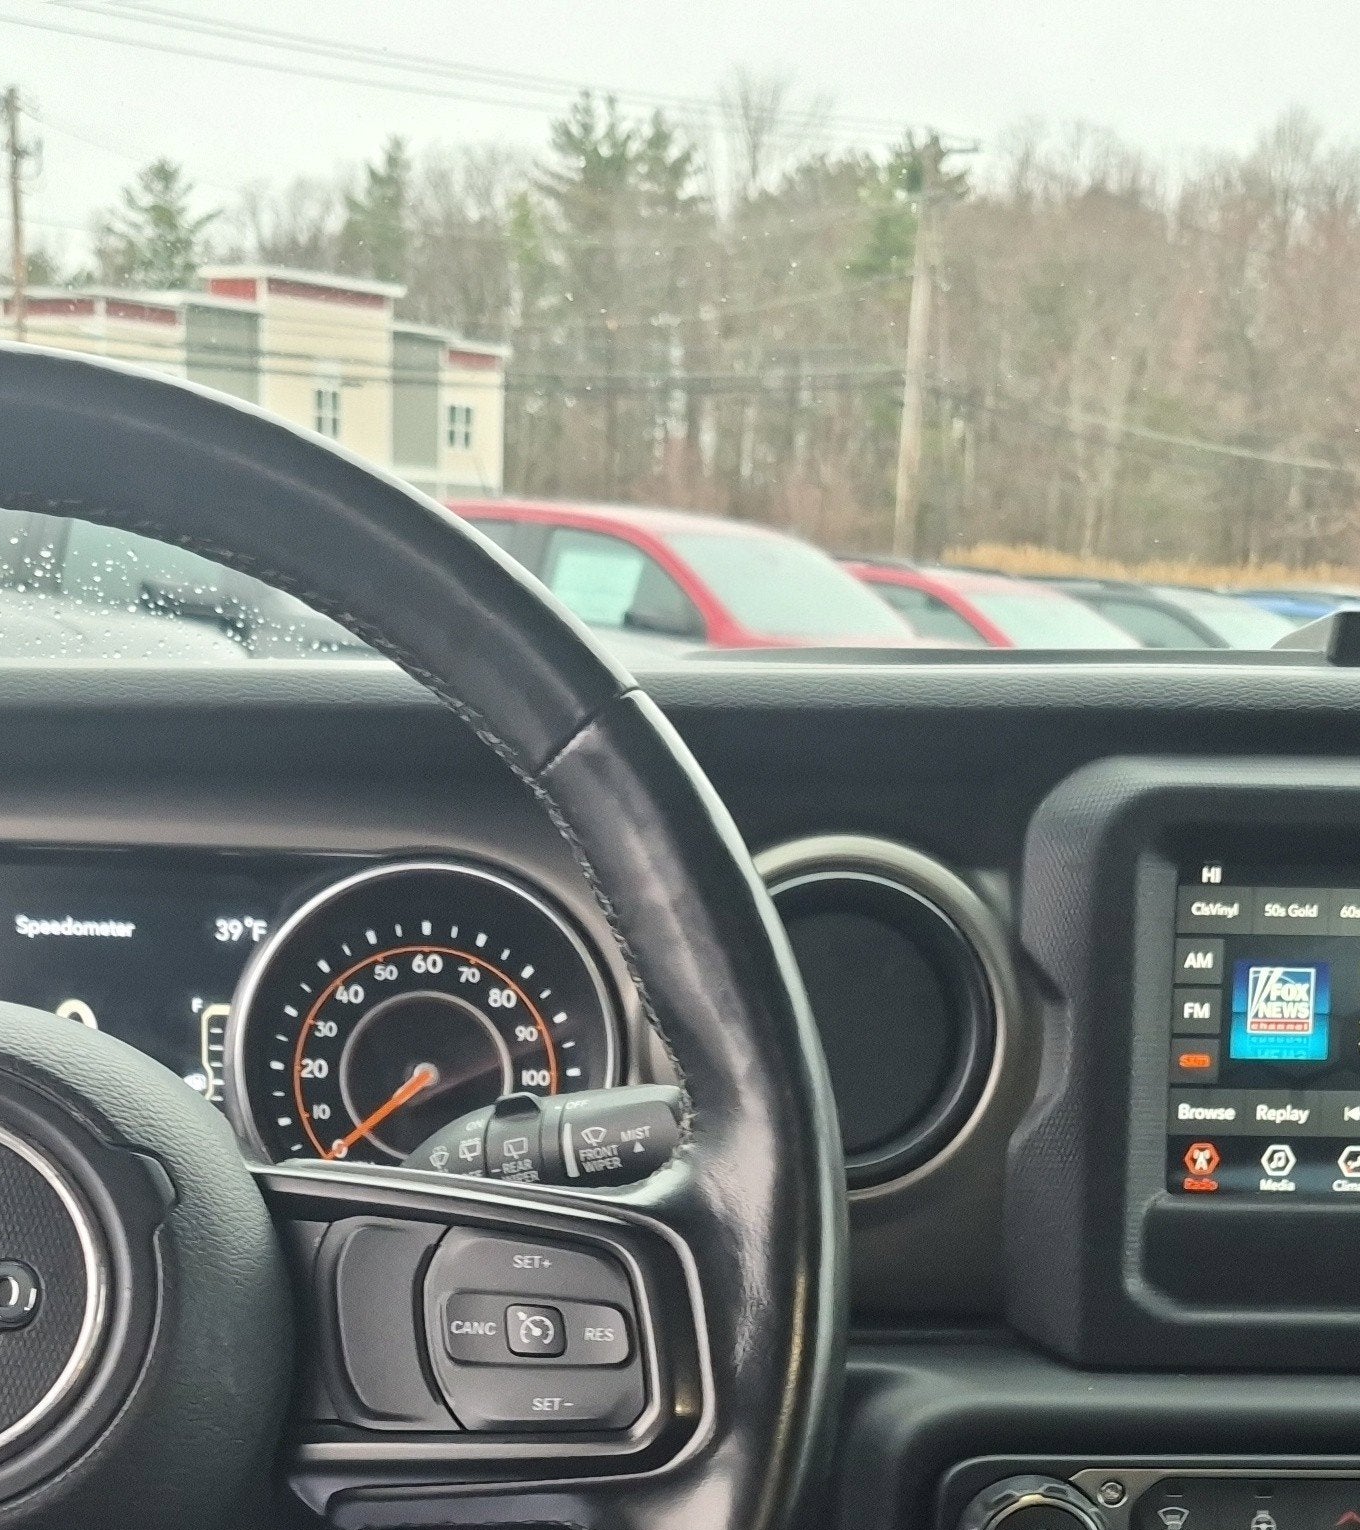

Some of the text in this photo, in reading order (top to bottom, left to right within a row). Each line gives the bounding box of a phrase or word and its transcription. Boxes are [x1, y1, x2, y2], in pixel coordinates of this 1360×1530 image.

[1191, 902, 1240, 919] ClsVinyl
[1264, 903, 1318, 918] 50s Gold
[15, 914, 136, 938] Speedometer
[412, 954, 444, 975] 60
[1183, 952, 1214, 969] AM
[374, 964, 399, 984] 50
[458, 965, 481, 984] 70
[336, 984, 364, 1004] 40
[488, 989, 518, 1009] 80
[1270, 983, 1310, 1001] FOX
[1183, 1002, 1211, 1020] FM
[1258, 1001, 1310, 1019] NEWS
[315, 1021, 338, 1039] 30
[515, 1026, 538, 1042] 90
[301, 1059, 329, 1080] 20
[521, 1070, 551, 1088] 100
[313, 1105, 331, 1120] 10
[1177, 1102, 1236, 1121] Browse
[1256, 1104, 1310, 1124] Replay
[621, 1125, 652, 1142] MIST
[579, 1144, 620, 1161] FRONT
[580, 1156, 623, 1173] WIPER
[1259, 1179, 1296, 1192] Media
[513, 1255, 552, 1270] SET+
[451, 1320, 497, 1336] CANC
[584, 1327, 615, 1342] RES
